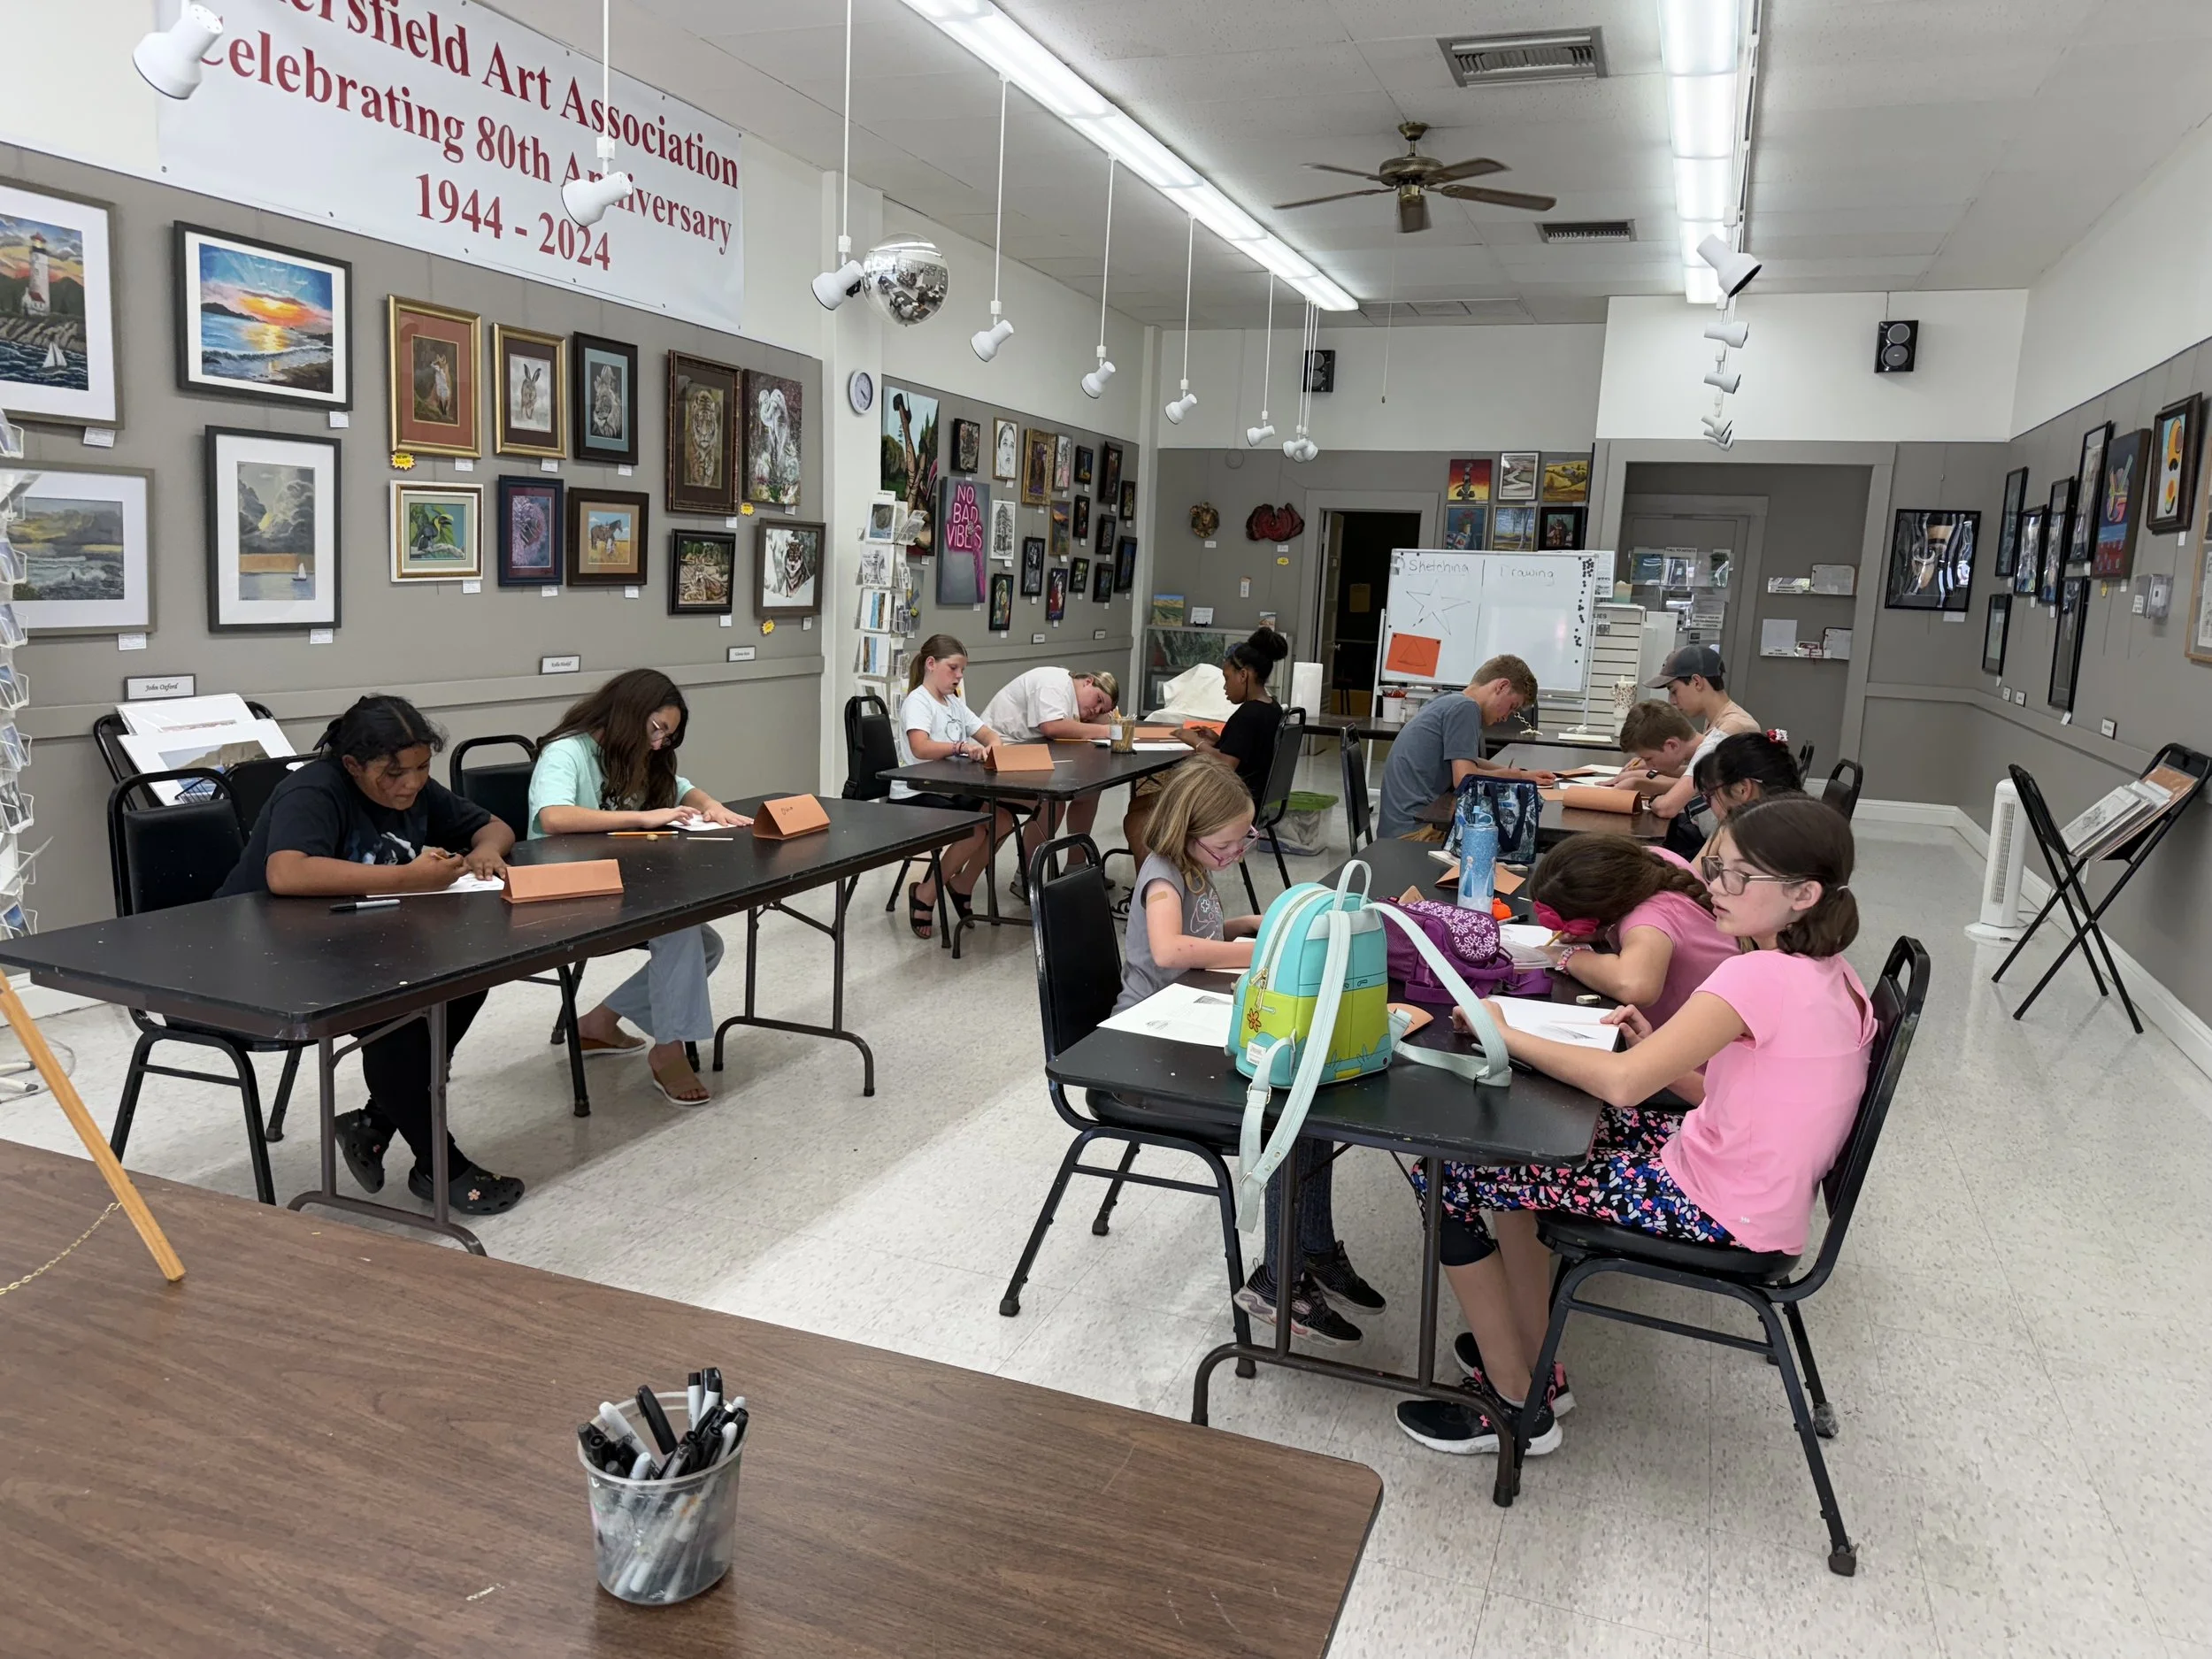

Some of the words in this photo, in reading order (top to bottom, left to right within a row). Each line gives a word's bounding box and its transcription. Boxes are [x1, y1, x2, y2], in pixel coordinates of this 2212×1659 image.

[482, 42, 551, 111] Art
[560, 76, 738, 189] Association
[476, 116, 552, 184] 80th
[561, 151, 733, 256] Aiversary
[416, 173, 503, 240] 1944
[515, 227, 527, 236] -
[539, 212, 611, 271] 2024
[956, 484, 975, 504] NO
[953, 502, 979, 524] BAD
[946, 523, 983, 549] VIBES
[144, 683, 158, 692] John
[159, 681, 179, 692] Oxford
